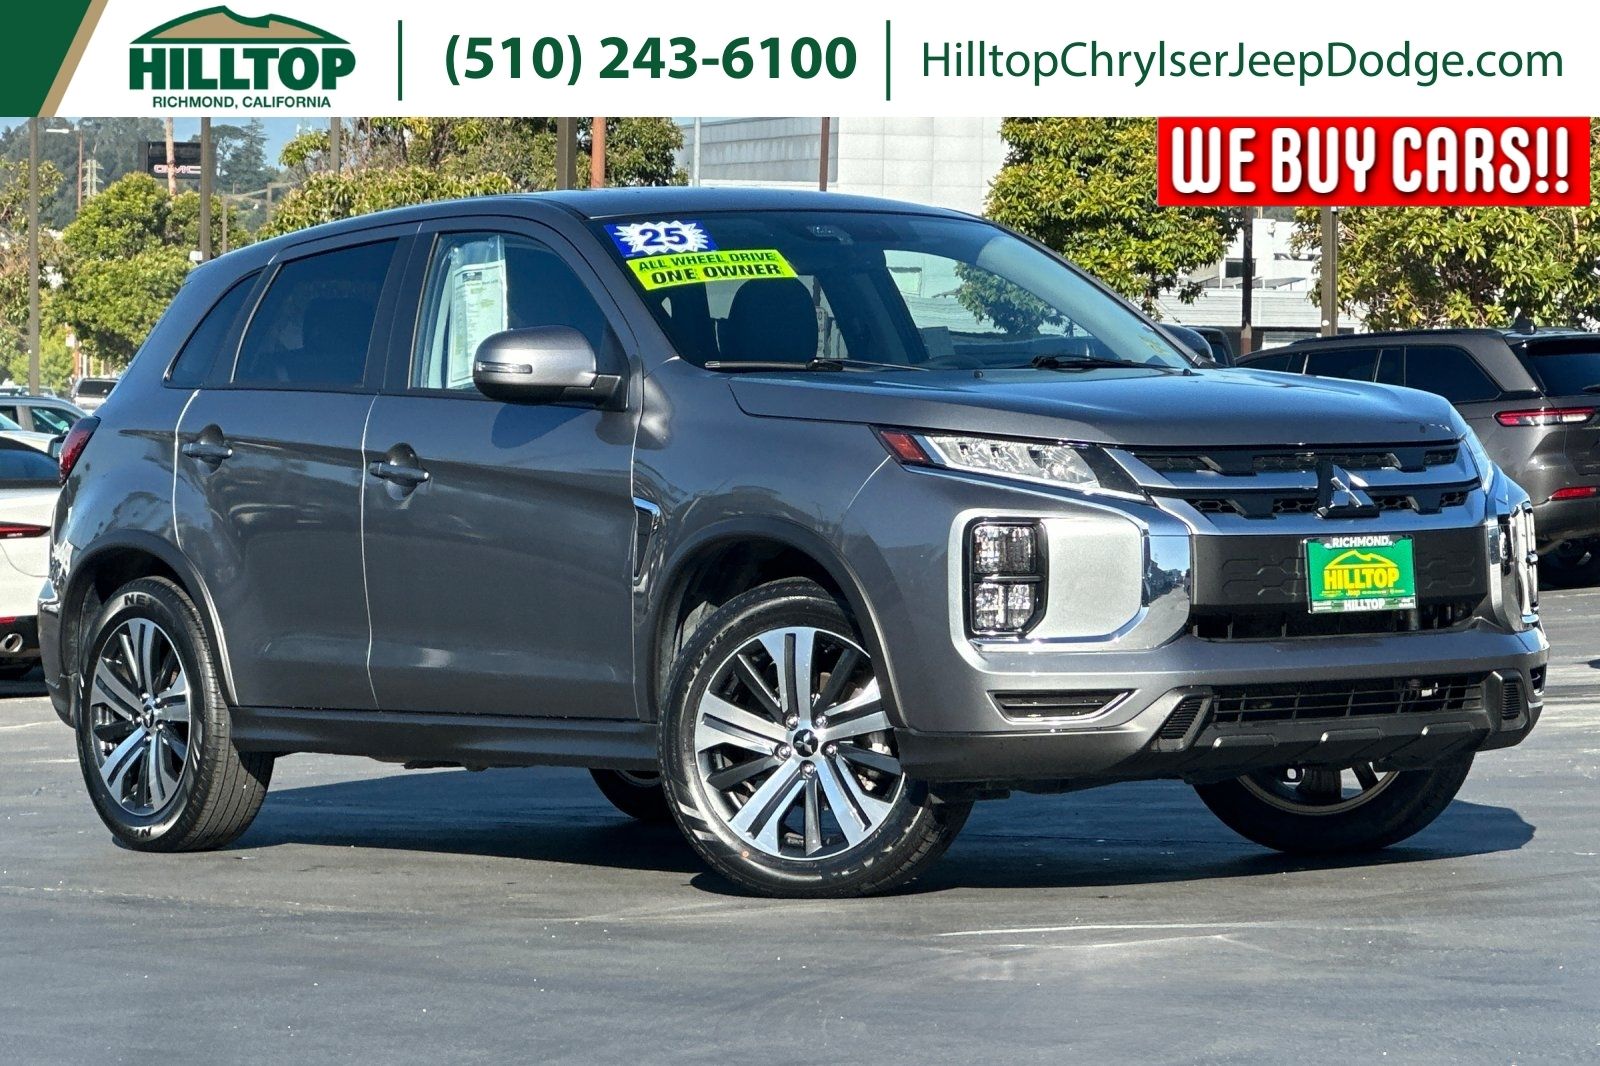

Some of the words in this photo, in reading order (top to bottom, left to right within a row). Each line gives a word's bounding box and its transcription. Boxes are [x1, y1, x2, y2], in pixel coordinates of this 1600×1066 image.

[639, 227, 688, 247] 25
[639, 260, 667, 272] ALL
[676, 256, 725, 266] WHEEL
[731, 251, 776, 262] DRIVE
[652, 268, 696, 284] ONE
[703, 263, 781, 278] OWNER
[1332, 536, 1389, 548] RICHMOND
[1324, 567, 1399, 589] HILLTOP
[1344, 598, 1385, 611] HILLTOP
